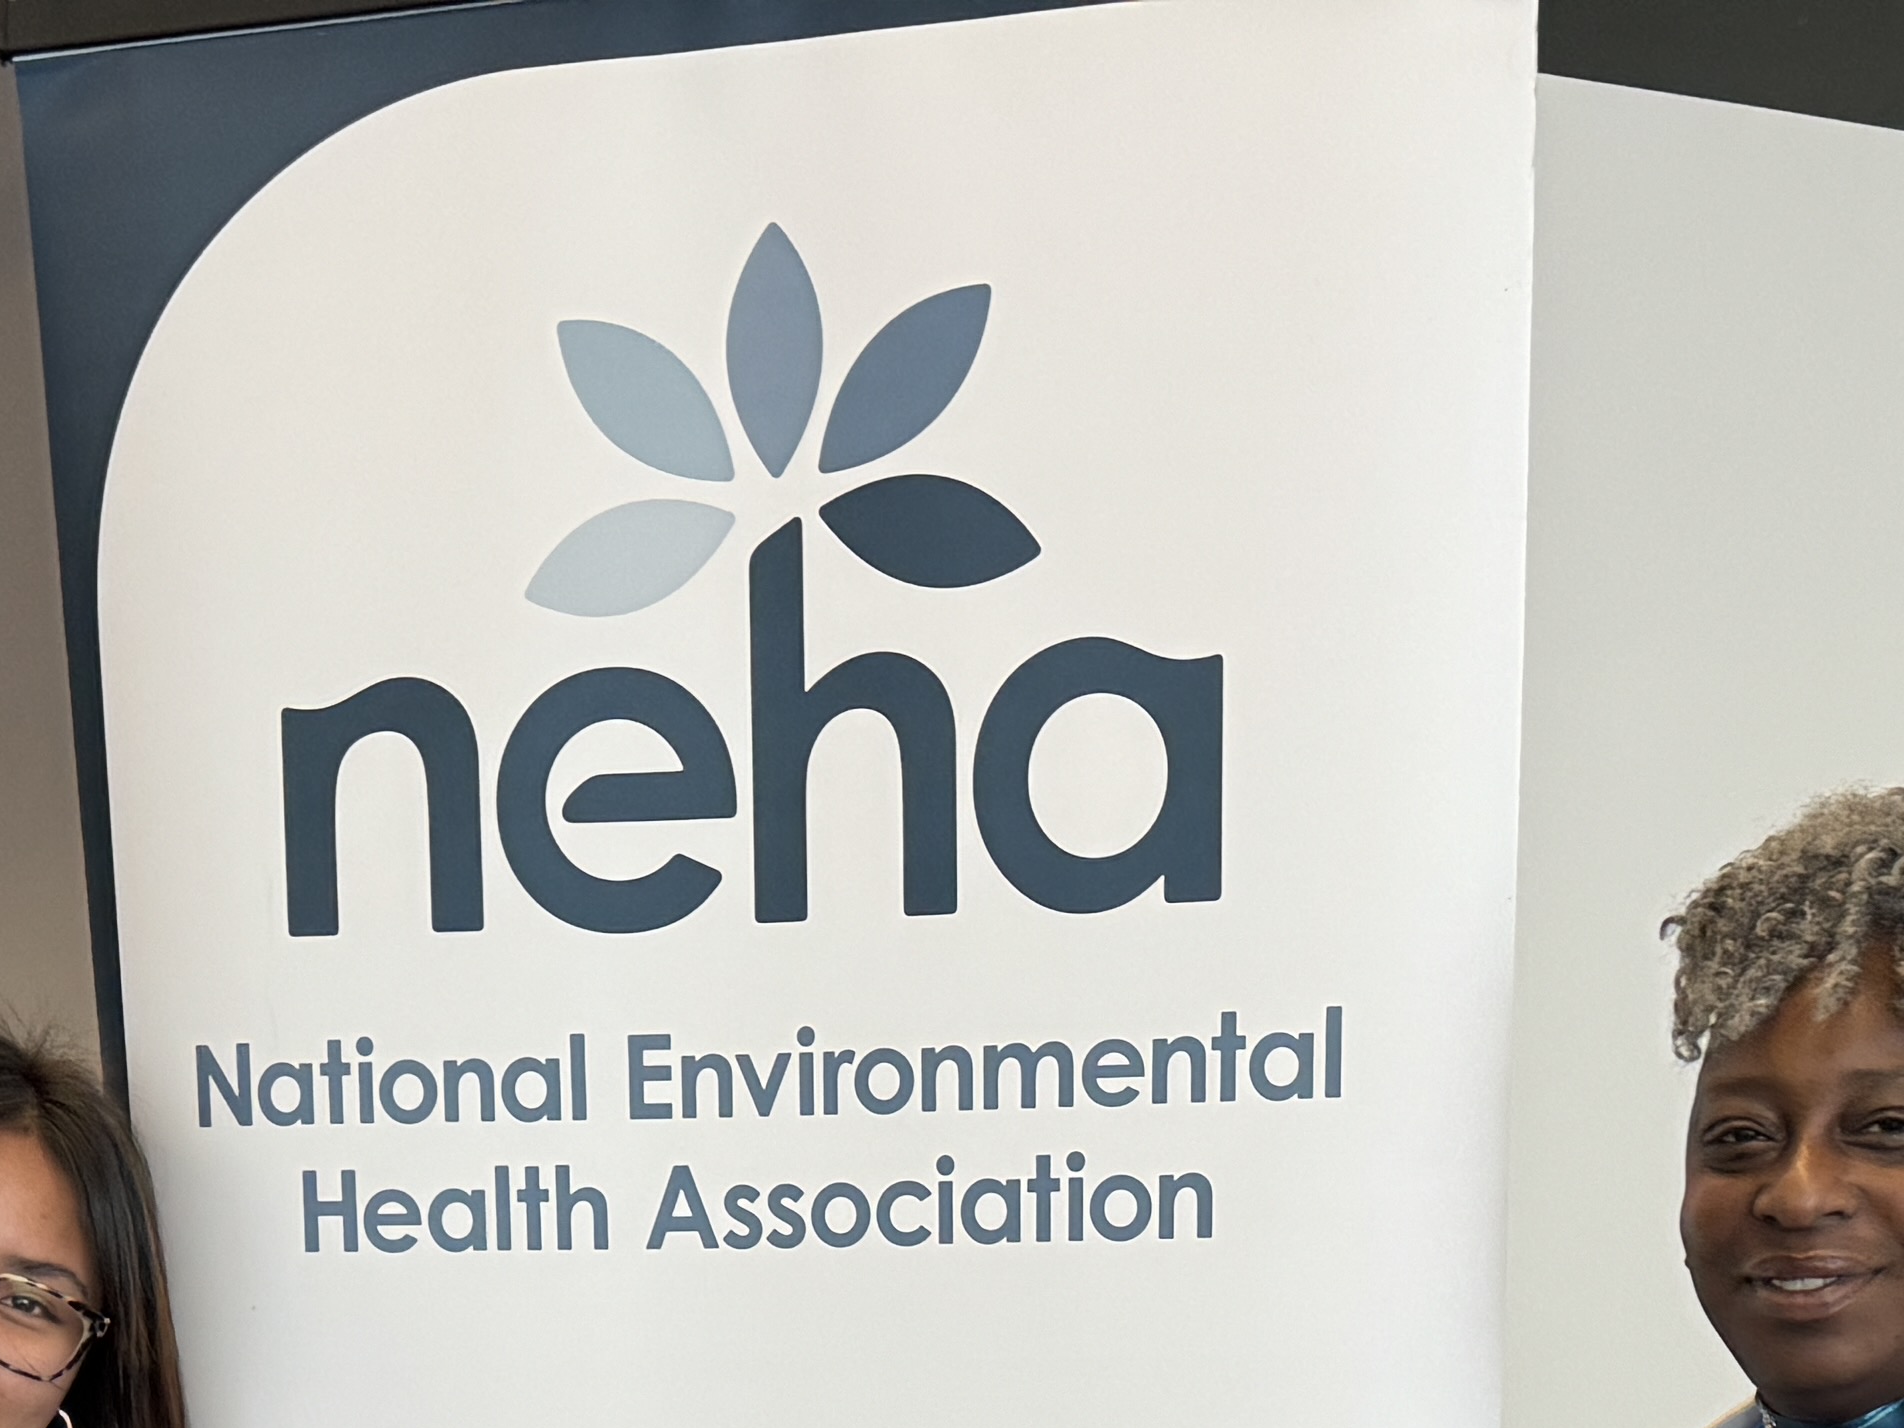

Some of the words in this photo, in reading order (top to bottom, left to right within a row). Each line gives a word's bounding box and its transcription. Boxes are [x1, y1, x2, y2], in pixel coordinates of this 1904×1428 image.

[281, 517, 1223, 937] neha
[195, 1033, 588, 1128] National
[627, 1005, 1343, 1120] Environmental
[302, 1164, 609, 1254] Health
[645, 1150, 1213, 1250] Association
